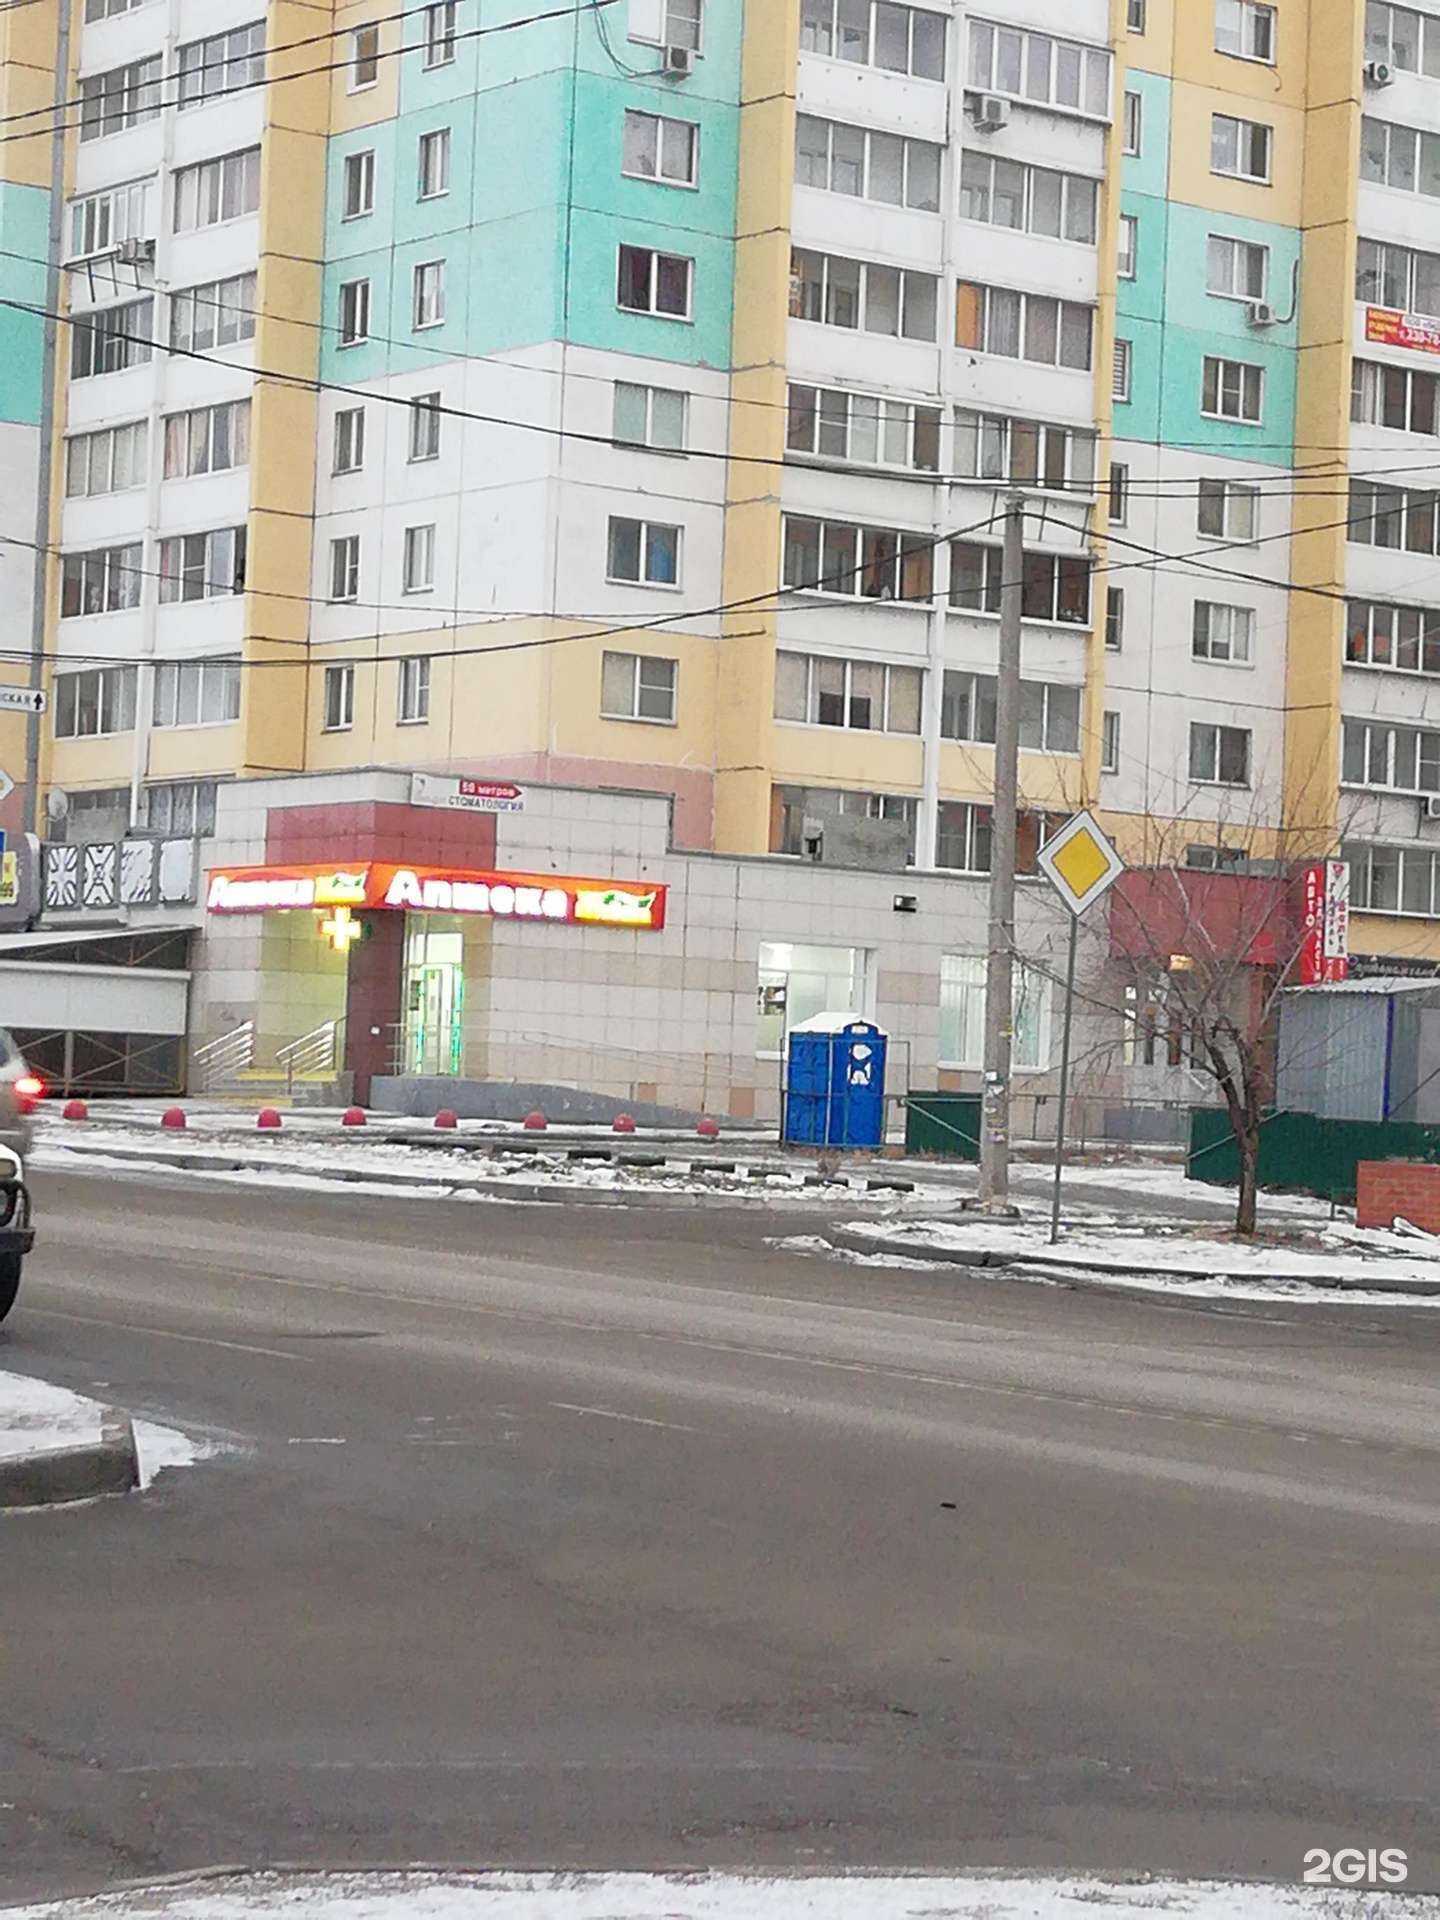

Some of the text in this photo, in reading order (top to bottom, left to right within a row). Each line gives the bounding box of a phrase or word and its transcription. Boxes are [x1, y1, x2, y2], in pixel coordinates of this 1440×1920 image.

[448, 796, 523, 810] СТОМАТОЛОГИЯ
[384, 870, 567, 919] Аптека
[1306, 871, 1316, 927] АВТО
